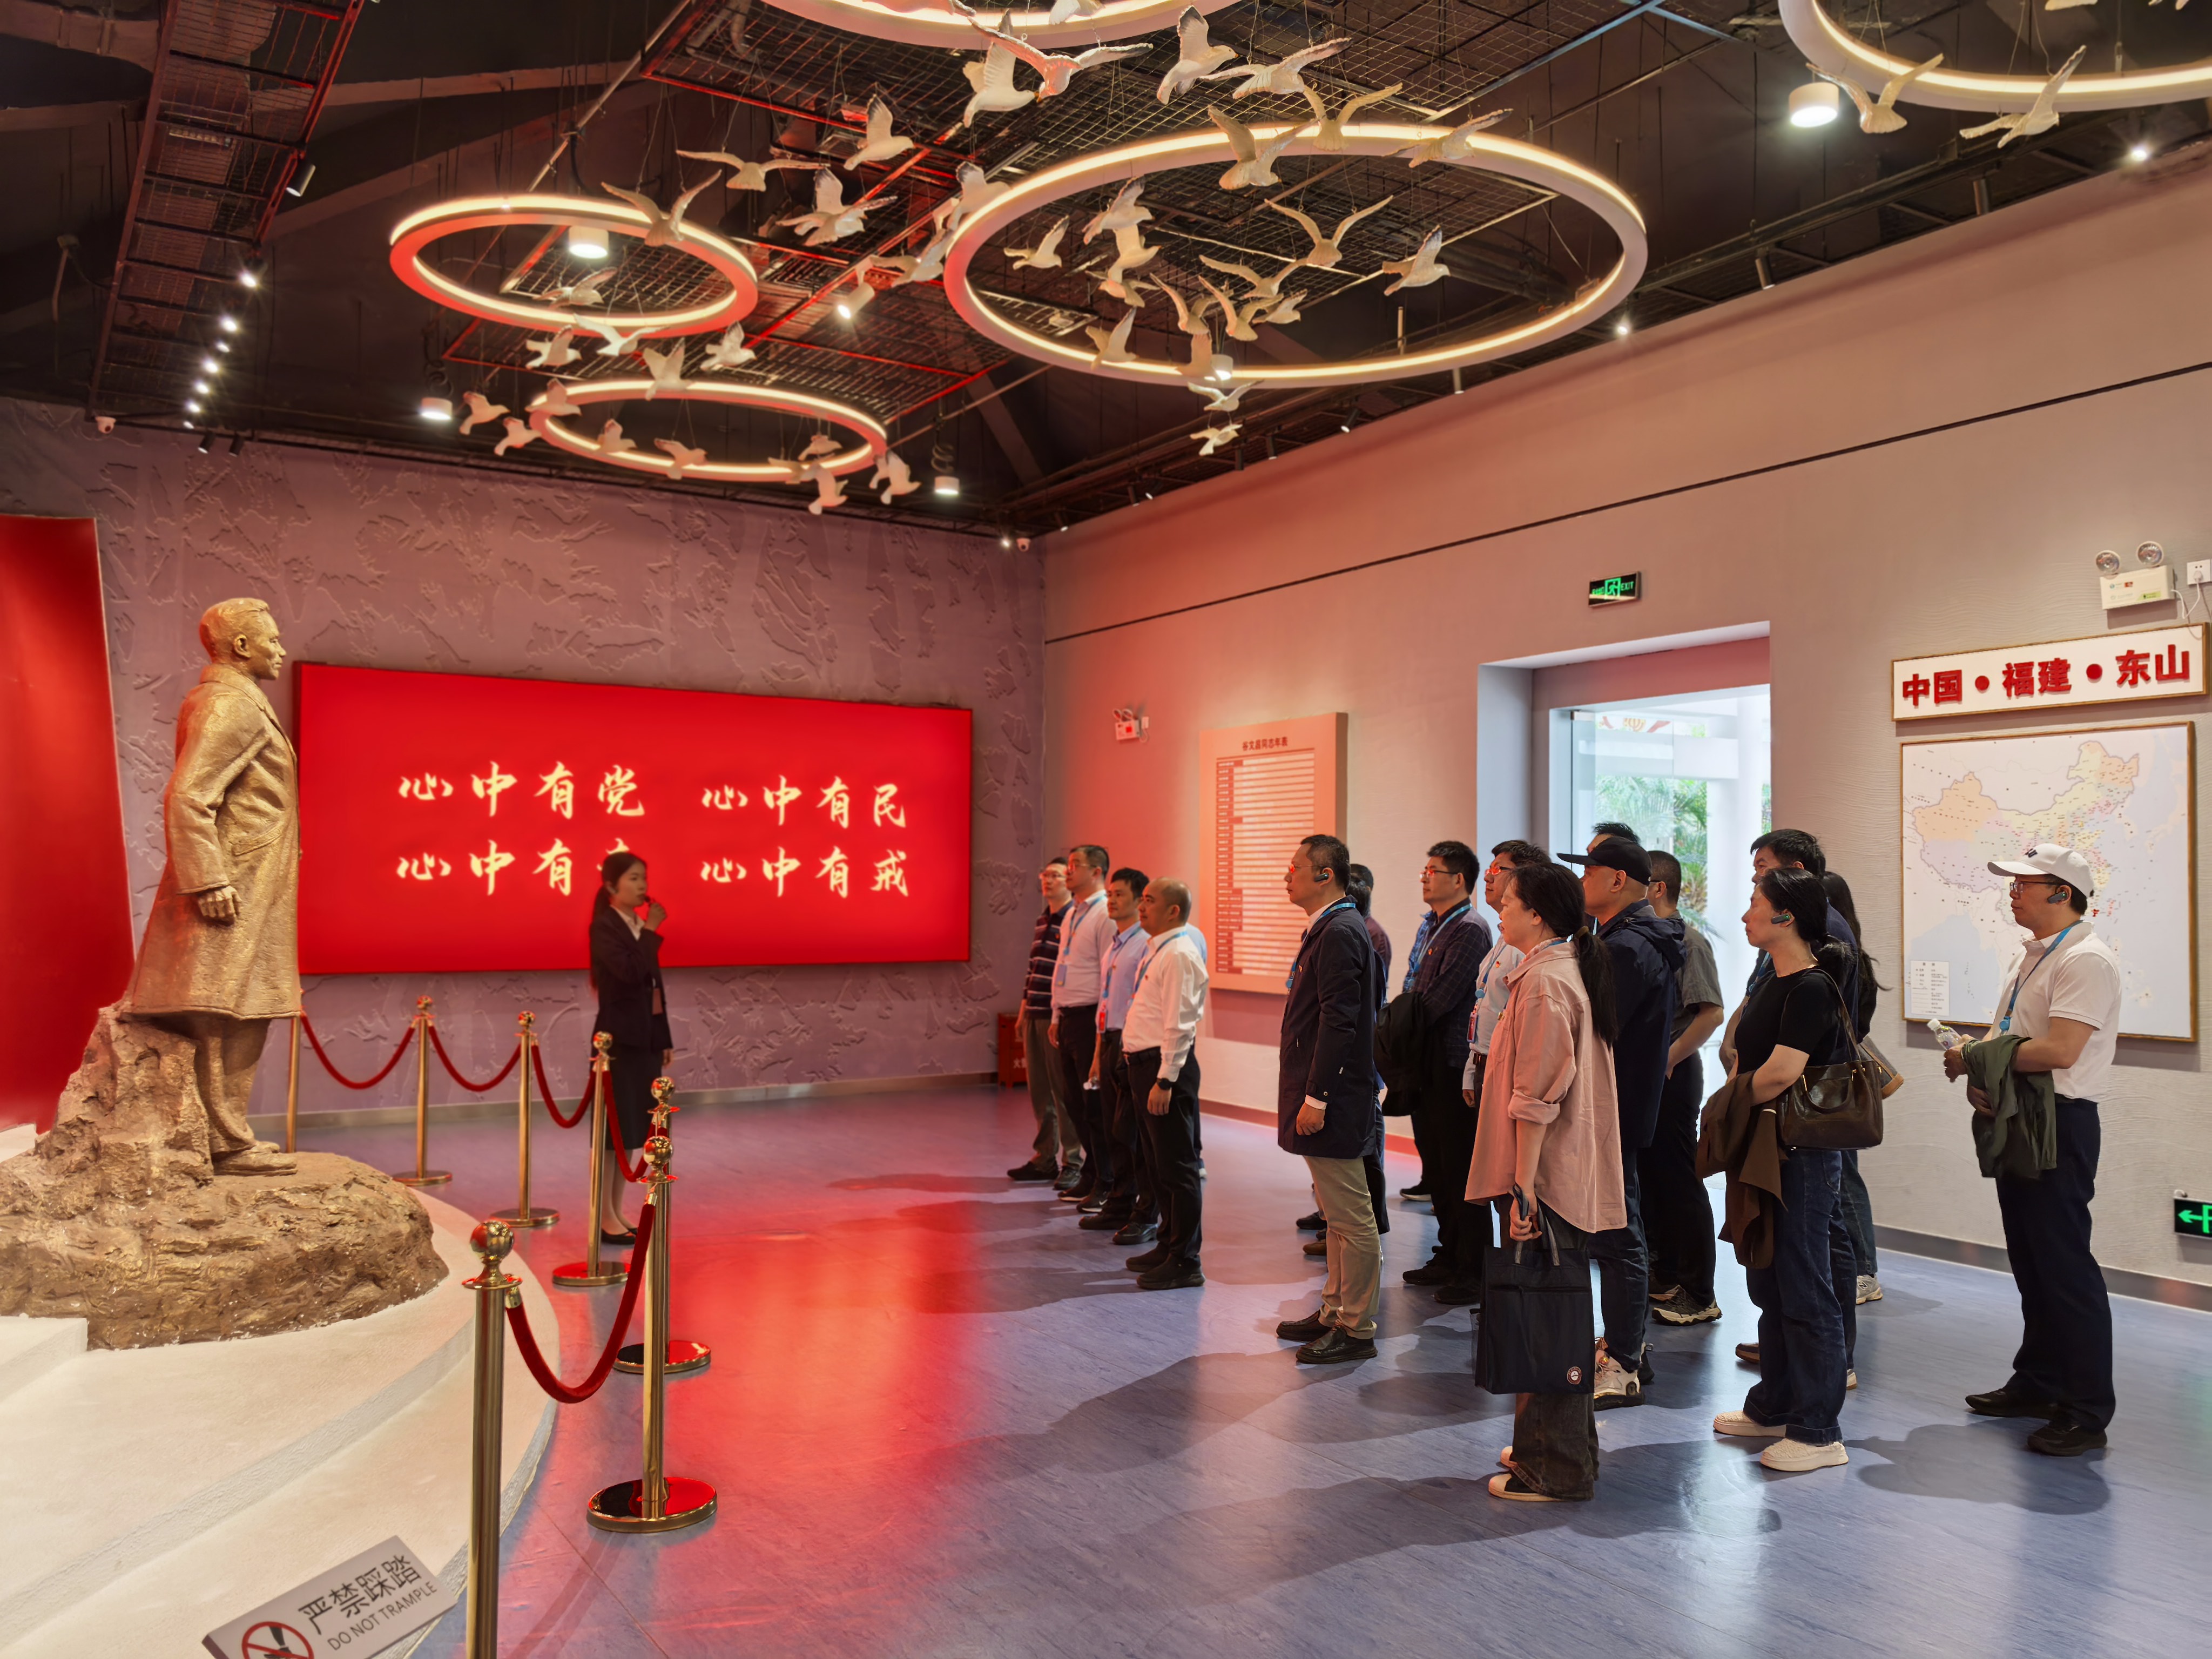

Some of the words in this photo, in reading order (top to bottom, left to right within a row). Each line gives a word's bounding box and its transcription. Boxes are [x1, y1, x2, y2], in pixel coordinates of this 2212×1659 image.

[397, 760, 645, 820] 心中有党
[701, 775, 907, 829] 心中有民
[396, 838, 629, 897] 心中有
[699, 845, 909, 899] 心中有戒
[298, 1555, 422, 1635] 严禁踩踏
[327, 1631, 352, 1651] DO
[350, 1613, 381, 1637] NOT
[378, 1581, 437, 1620] TRAMPLE
